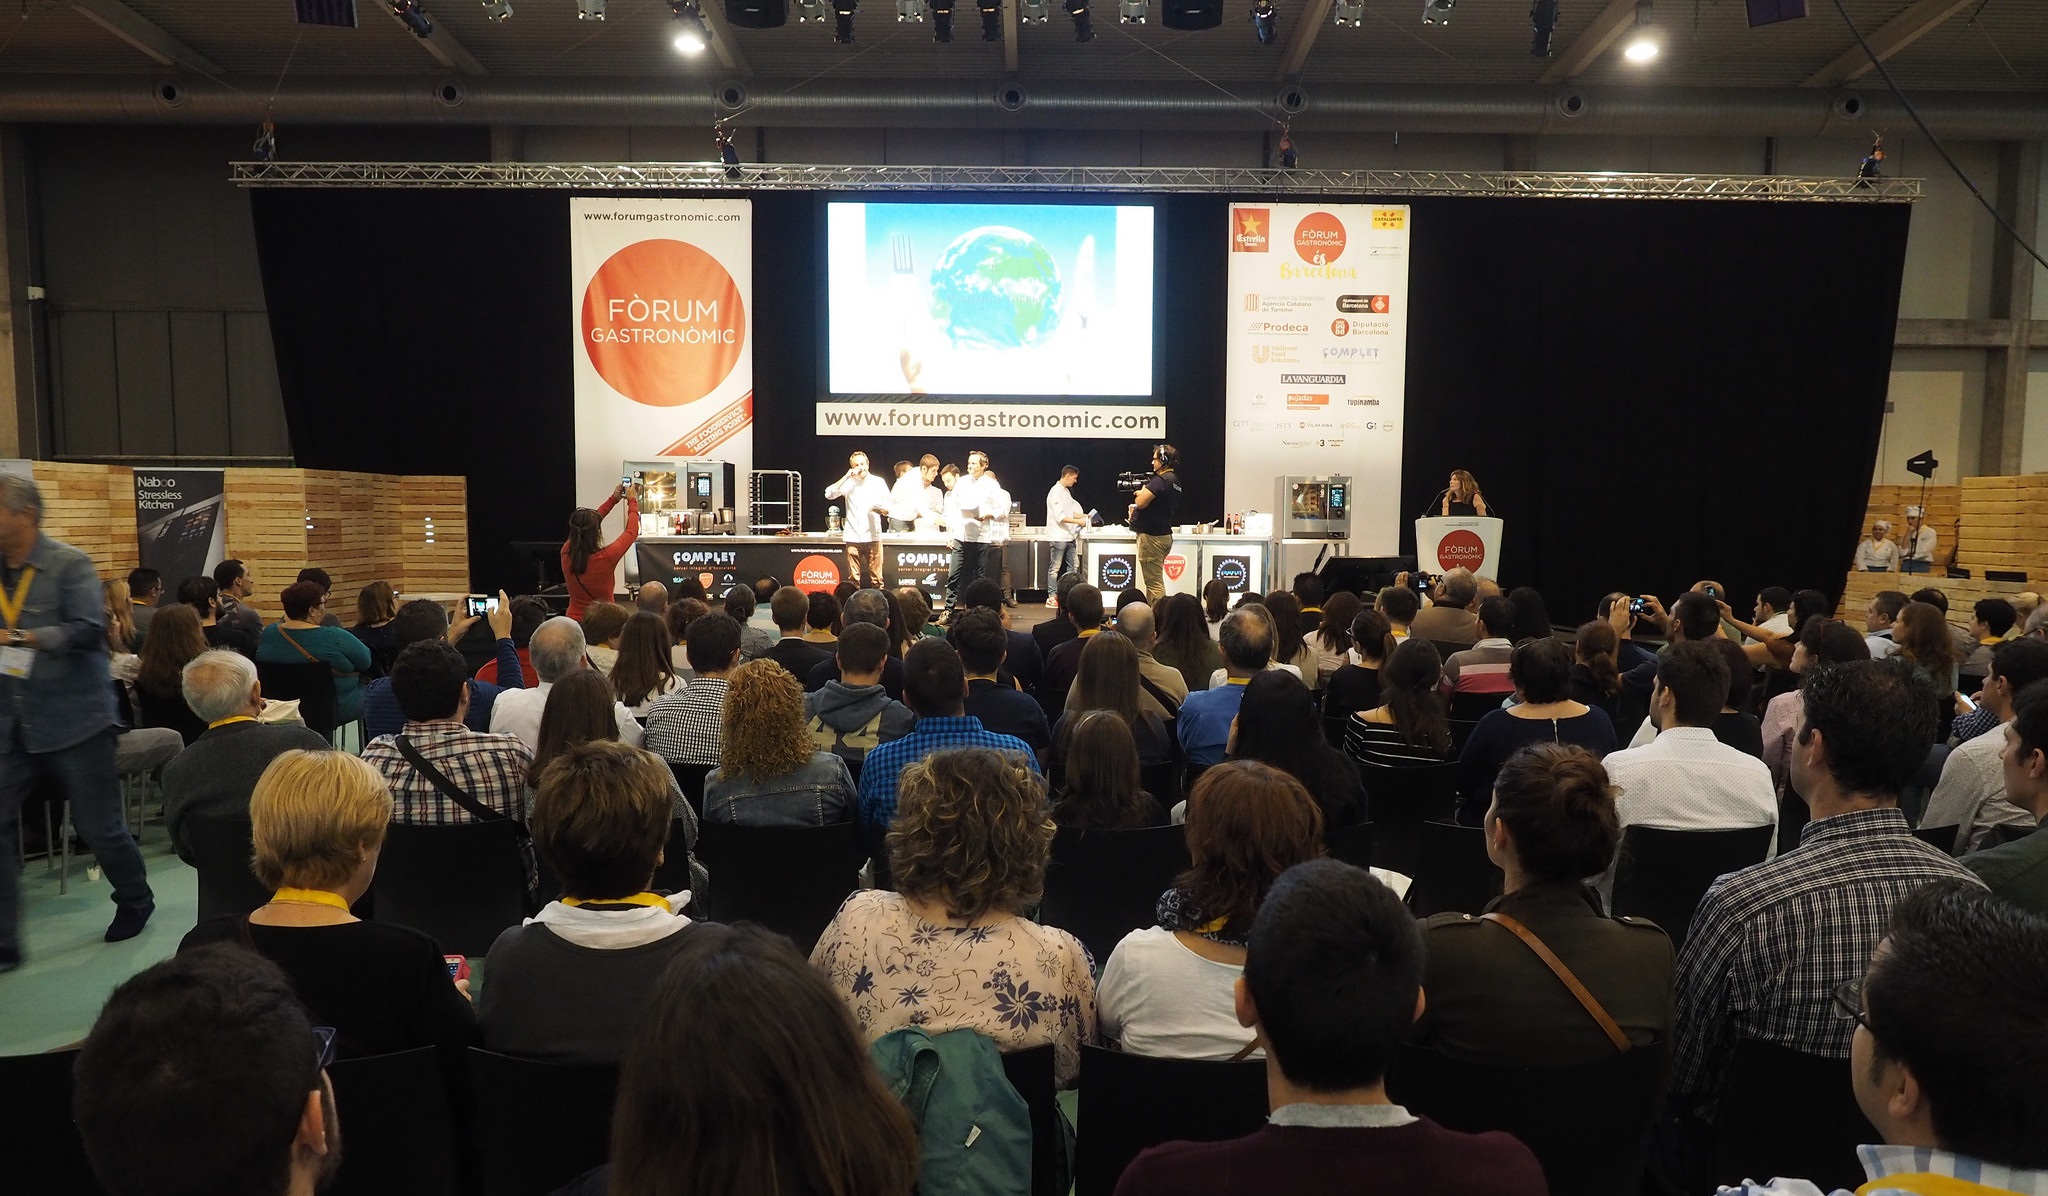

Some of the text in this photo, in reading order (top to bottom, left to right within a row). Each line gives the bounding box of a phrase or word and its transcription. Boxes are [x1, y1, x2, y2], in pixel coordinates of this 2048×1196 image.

[584, 212, 741, 222] www.forumgastronomic.com
[1236, 234, 1266, 243] Estrella
[1302, 228, 1338, 239] FÒRUM
[1280, 261, 1357, 280] Barcelona
[608, 293, 718, 323] FÒRUM
[1263, 322, 1309, 332] Prodeca
[1352, 321, 1389, 329] Diputació
[590, 326, 735, 344] GASTRONÒMIC
[1322, 347, 1380, 359] COMPLET
[1288, 394, 1313, 402] pujadas
[825, 408, 1160, 431] www.forumgastronomic.com
[684, 405, 745, 449] THE FOODSERVICE
[693, 414, 745, 452] MEETING POINT
[137, 476, 176, 488] Naboo
[138, 490, 182, 500] Stressless
[139, 500, 174, 509] Kitchen
[1444, 545, 1478, 553] FÒRUM
[673, 552, 736, 565] COMPLET
[897, 553, 952, 567] COMPLE
[801, 570, 832, 579] FÒRUM
